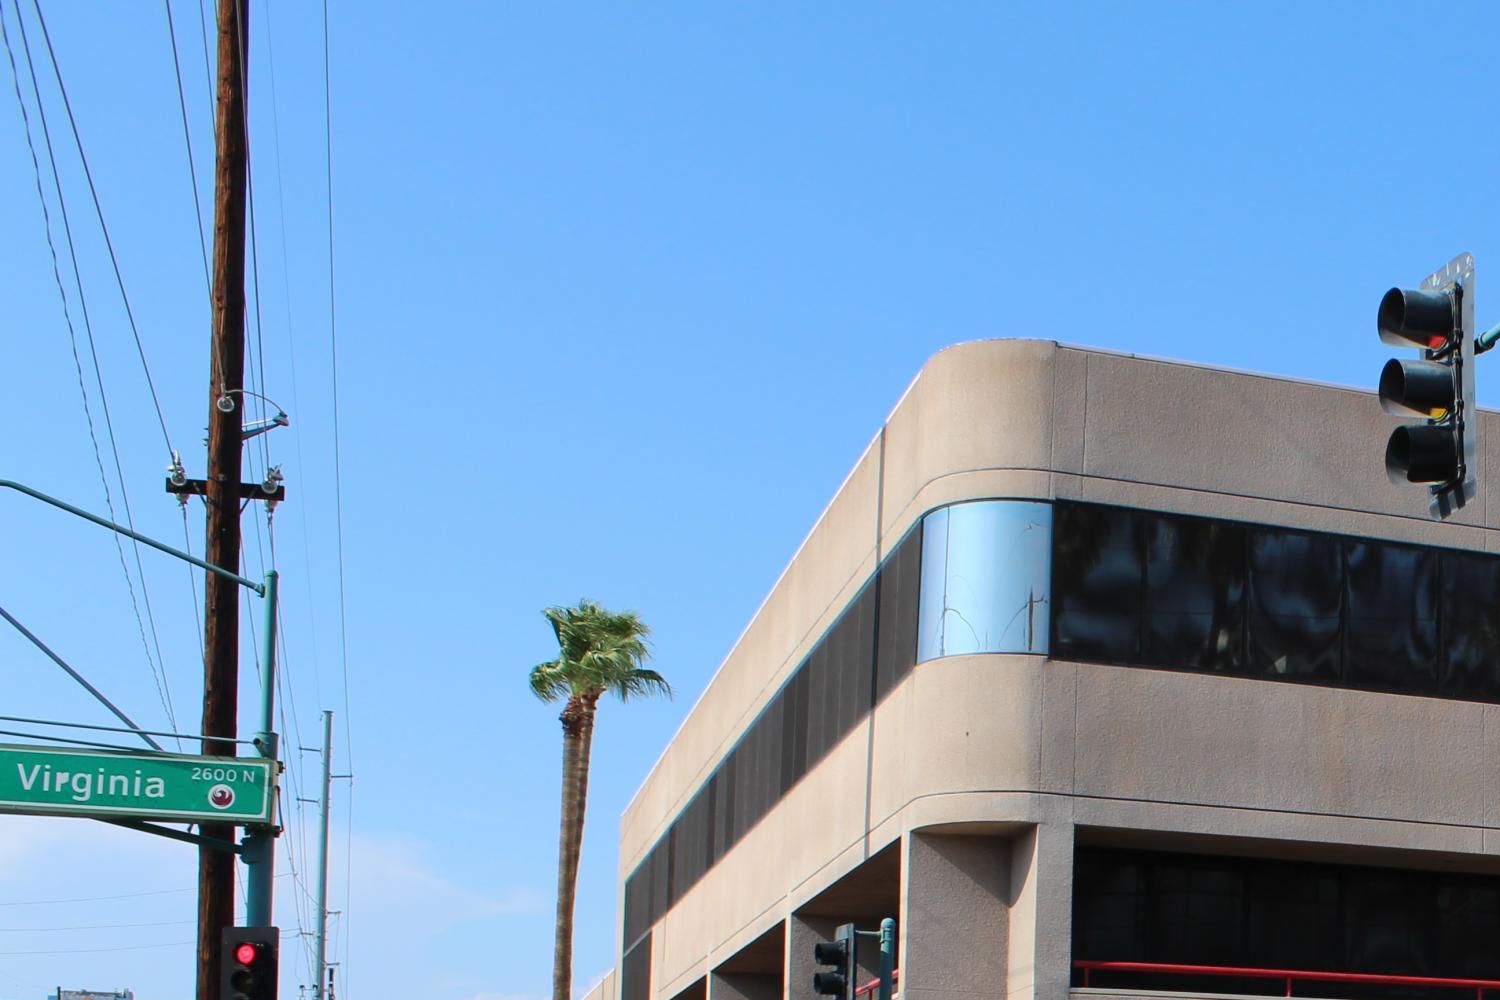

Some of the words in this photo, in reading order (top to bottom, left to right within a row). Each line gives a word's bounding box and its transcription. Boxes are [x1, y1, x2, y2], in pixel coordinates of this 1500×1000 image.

[16, 763, 165, 801] Virginia
[191, 767, 237, 782] 2600
[243, 769, 255, 783] N
